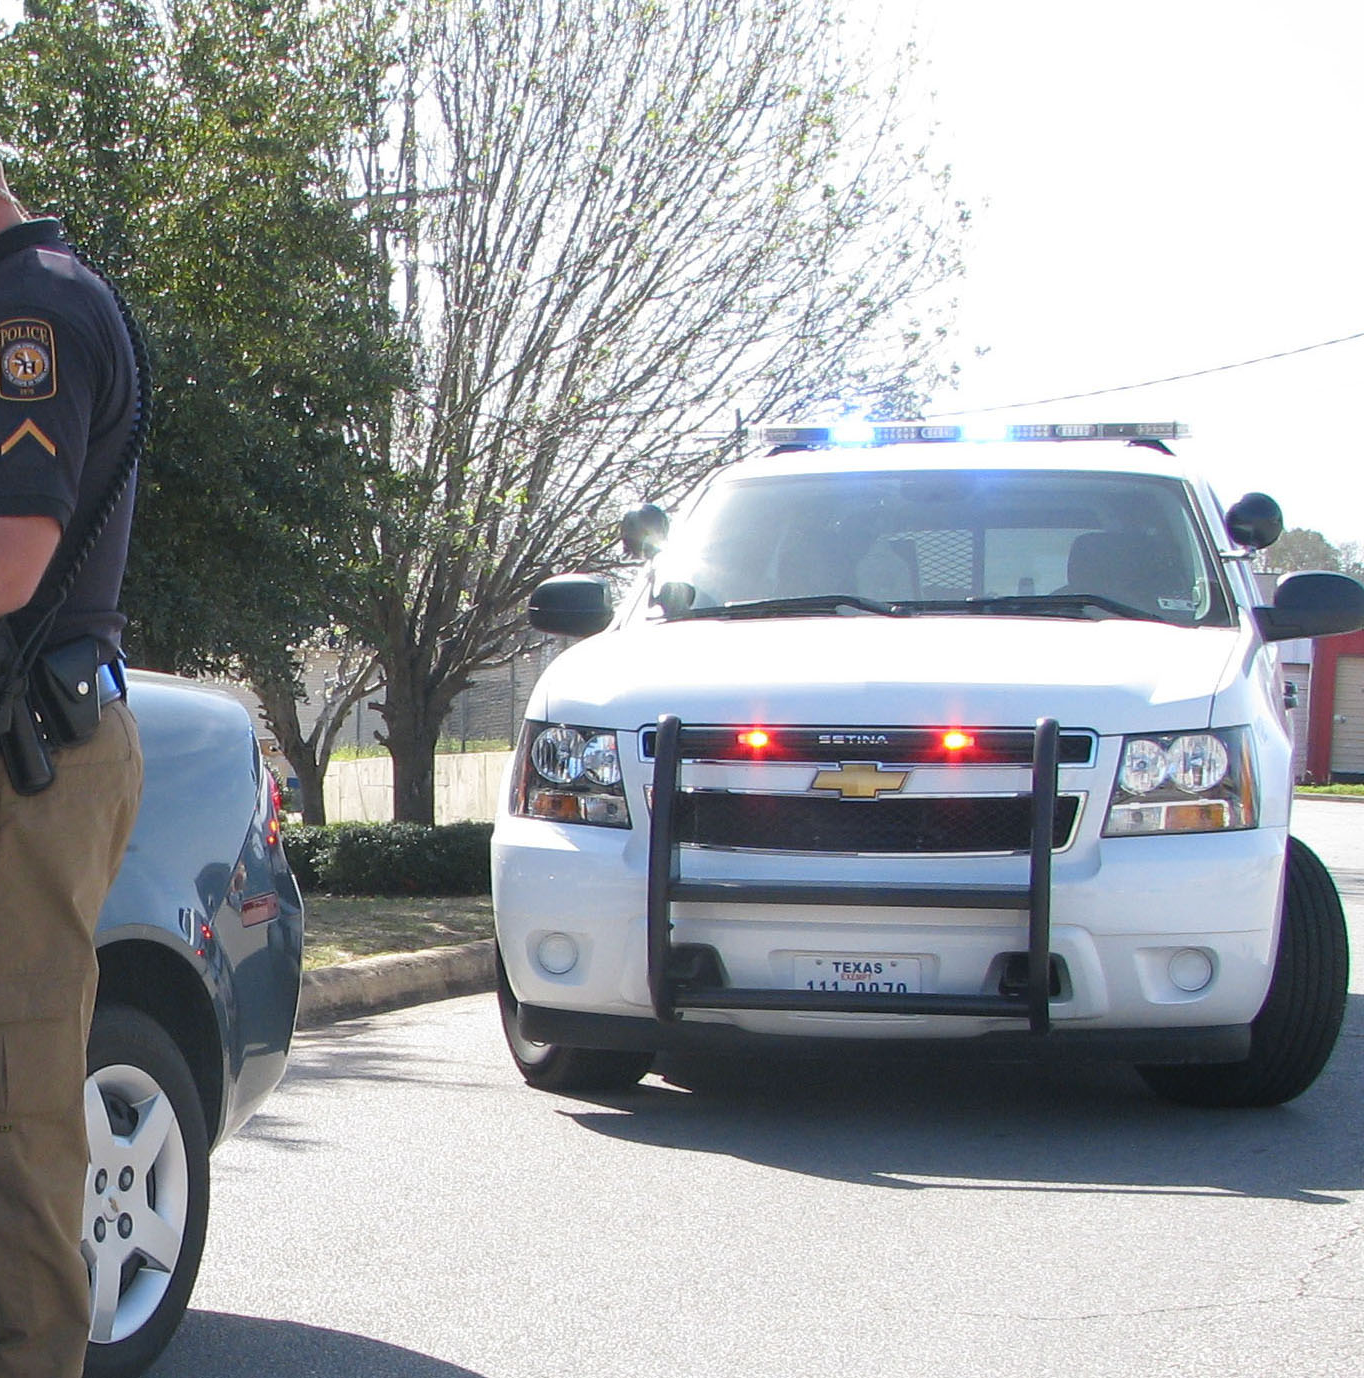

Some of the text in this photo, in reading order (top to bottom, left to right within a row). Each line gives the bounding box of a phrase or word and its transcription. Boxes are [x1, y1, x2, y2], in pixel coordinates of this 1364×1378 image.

[0, 326, 50, 347] POLICE
[818, 734, 889, 745] SETINA
[832, 961, 883, 974] TEXAS
